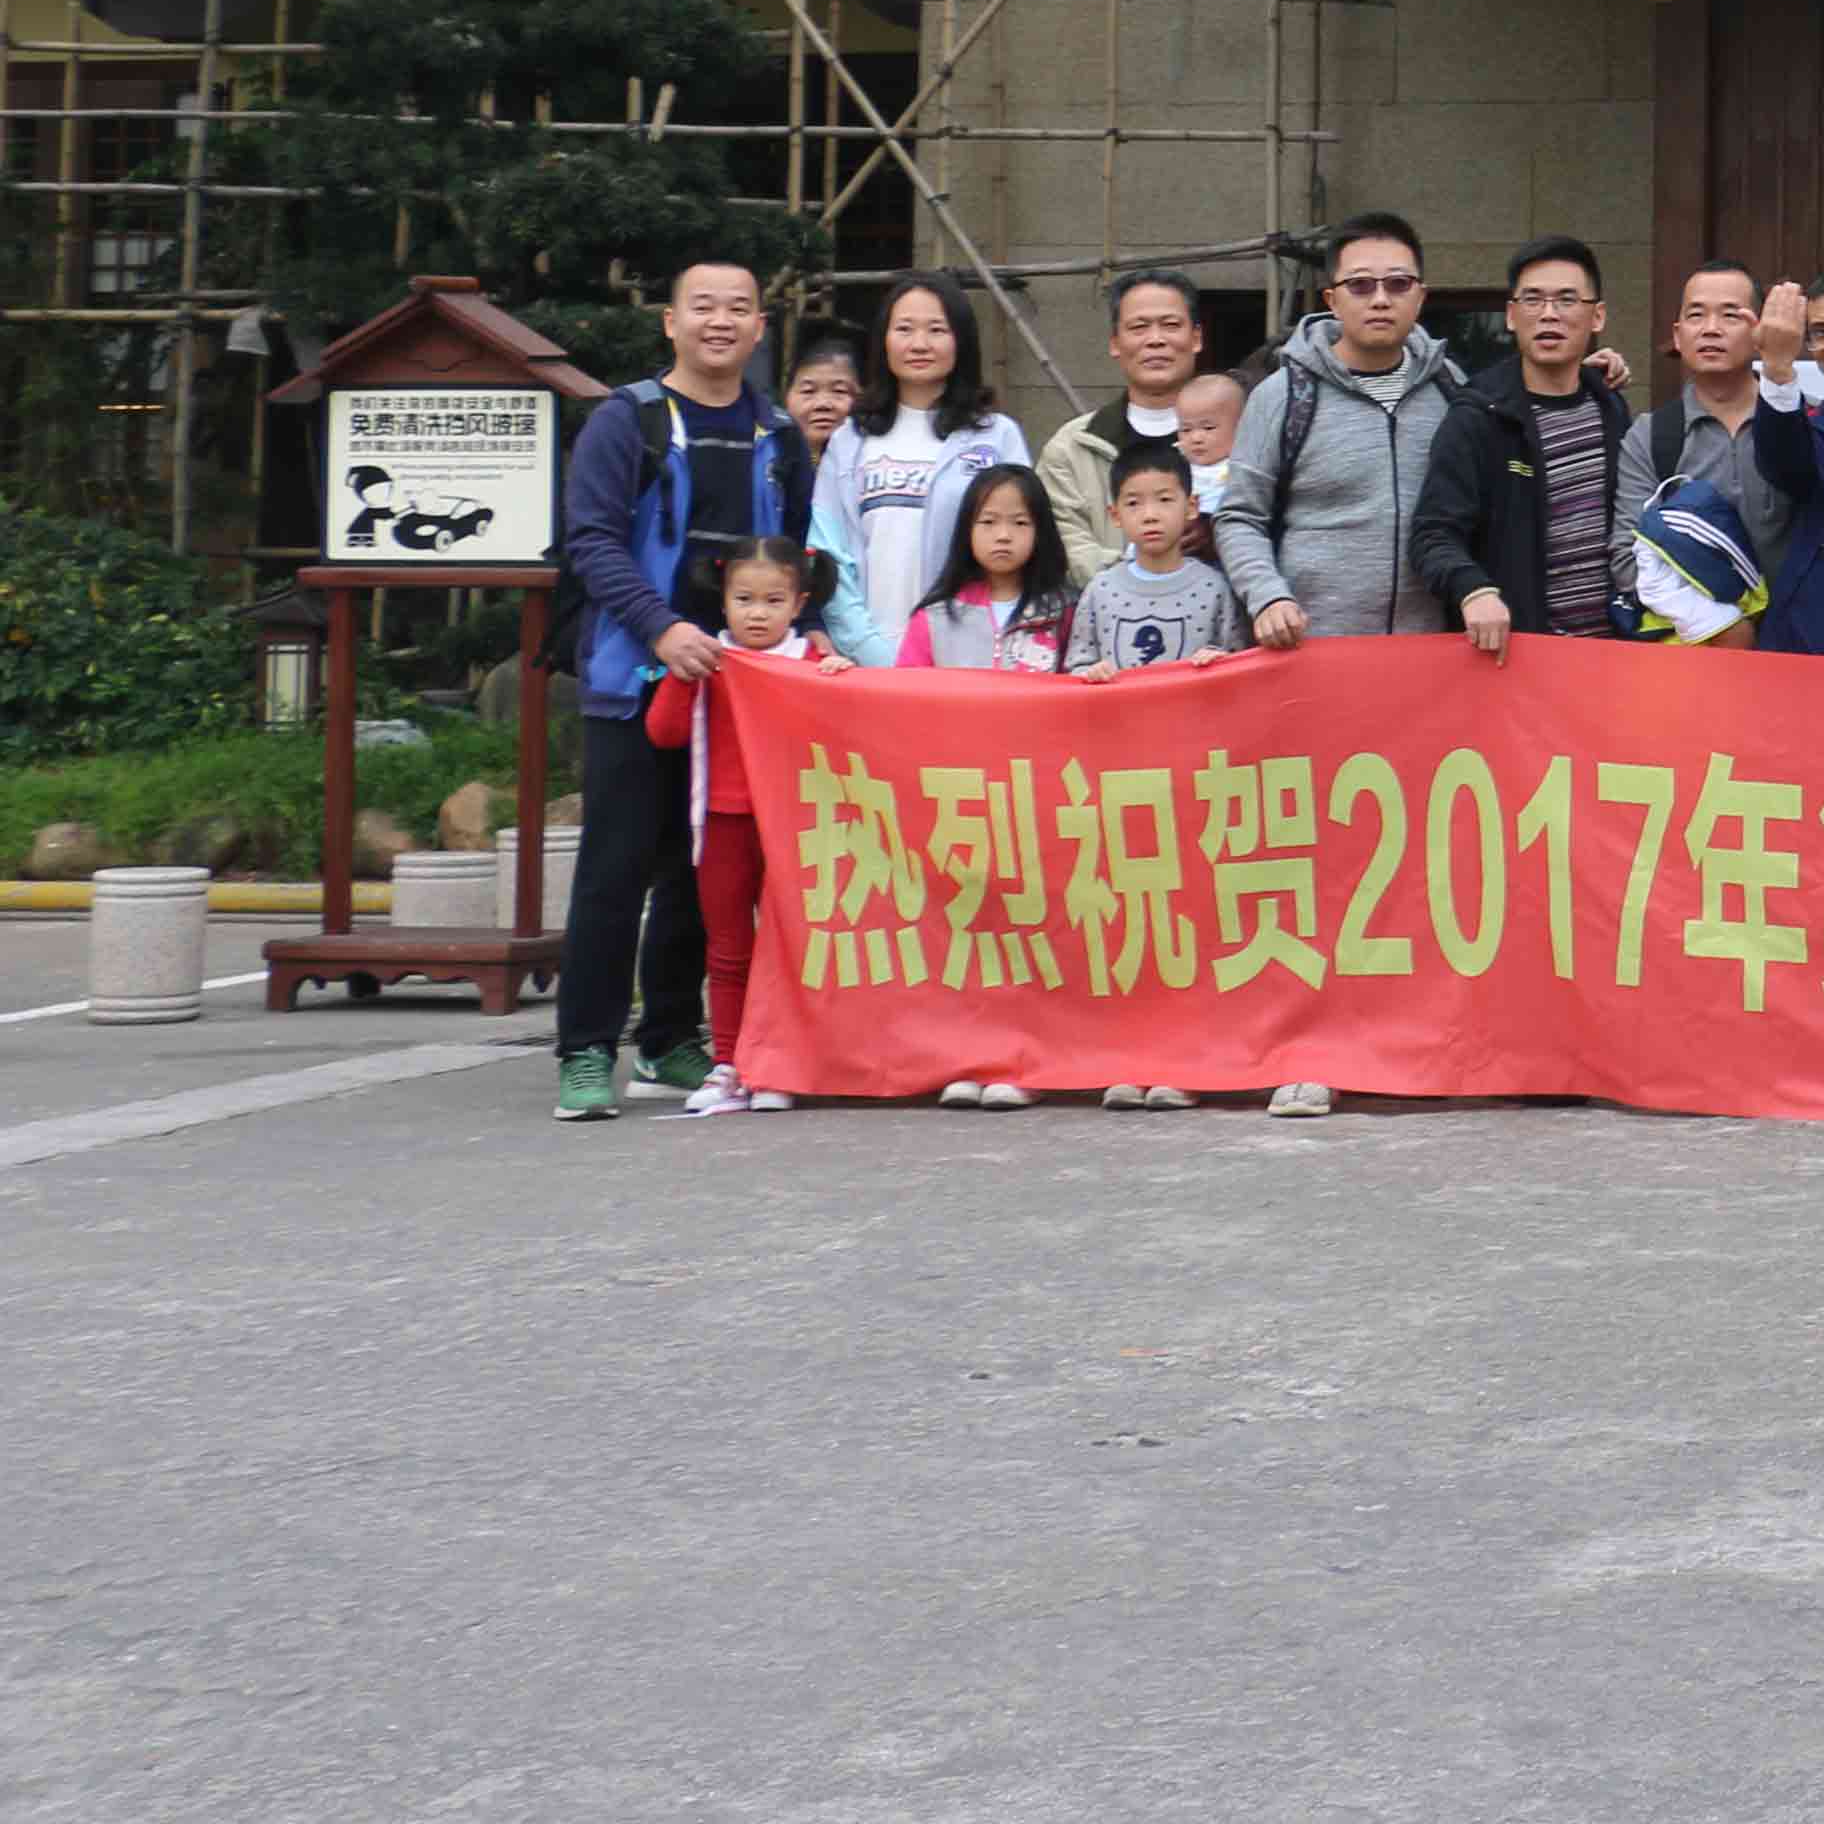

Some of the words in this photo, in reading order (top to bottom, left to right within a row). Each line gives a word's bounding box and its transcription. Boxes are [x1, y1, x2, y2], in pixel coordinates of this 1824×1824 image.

[350, 413, 537, 437] 免费清洗挡风玻璃
